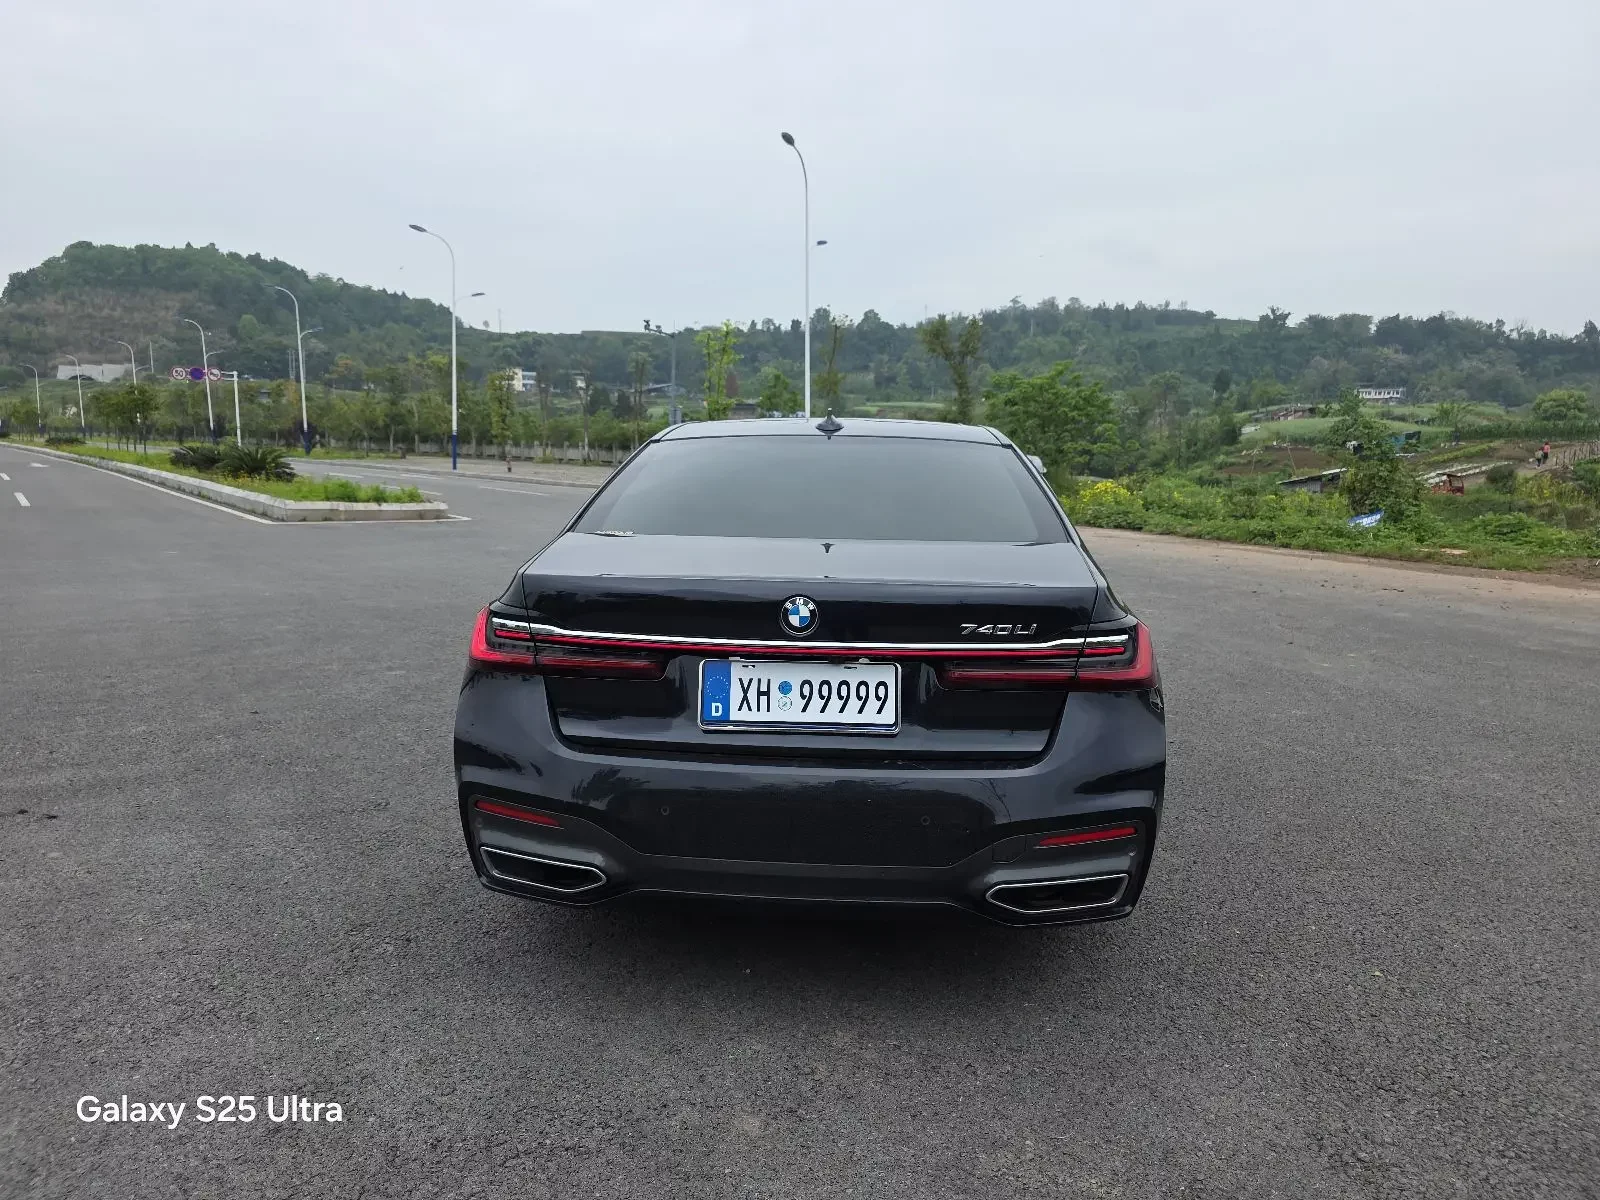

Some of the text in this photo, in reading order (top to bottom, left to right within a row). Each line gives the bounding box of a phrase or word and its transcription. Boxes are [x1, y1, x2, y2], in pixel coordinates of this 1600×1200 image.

[784, 598, 815, 610] BMW
[738, 677, 889, 714] XH 99999
[711, 702, 723, 717] D
